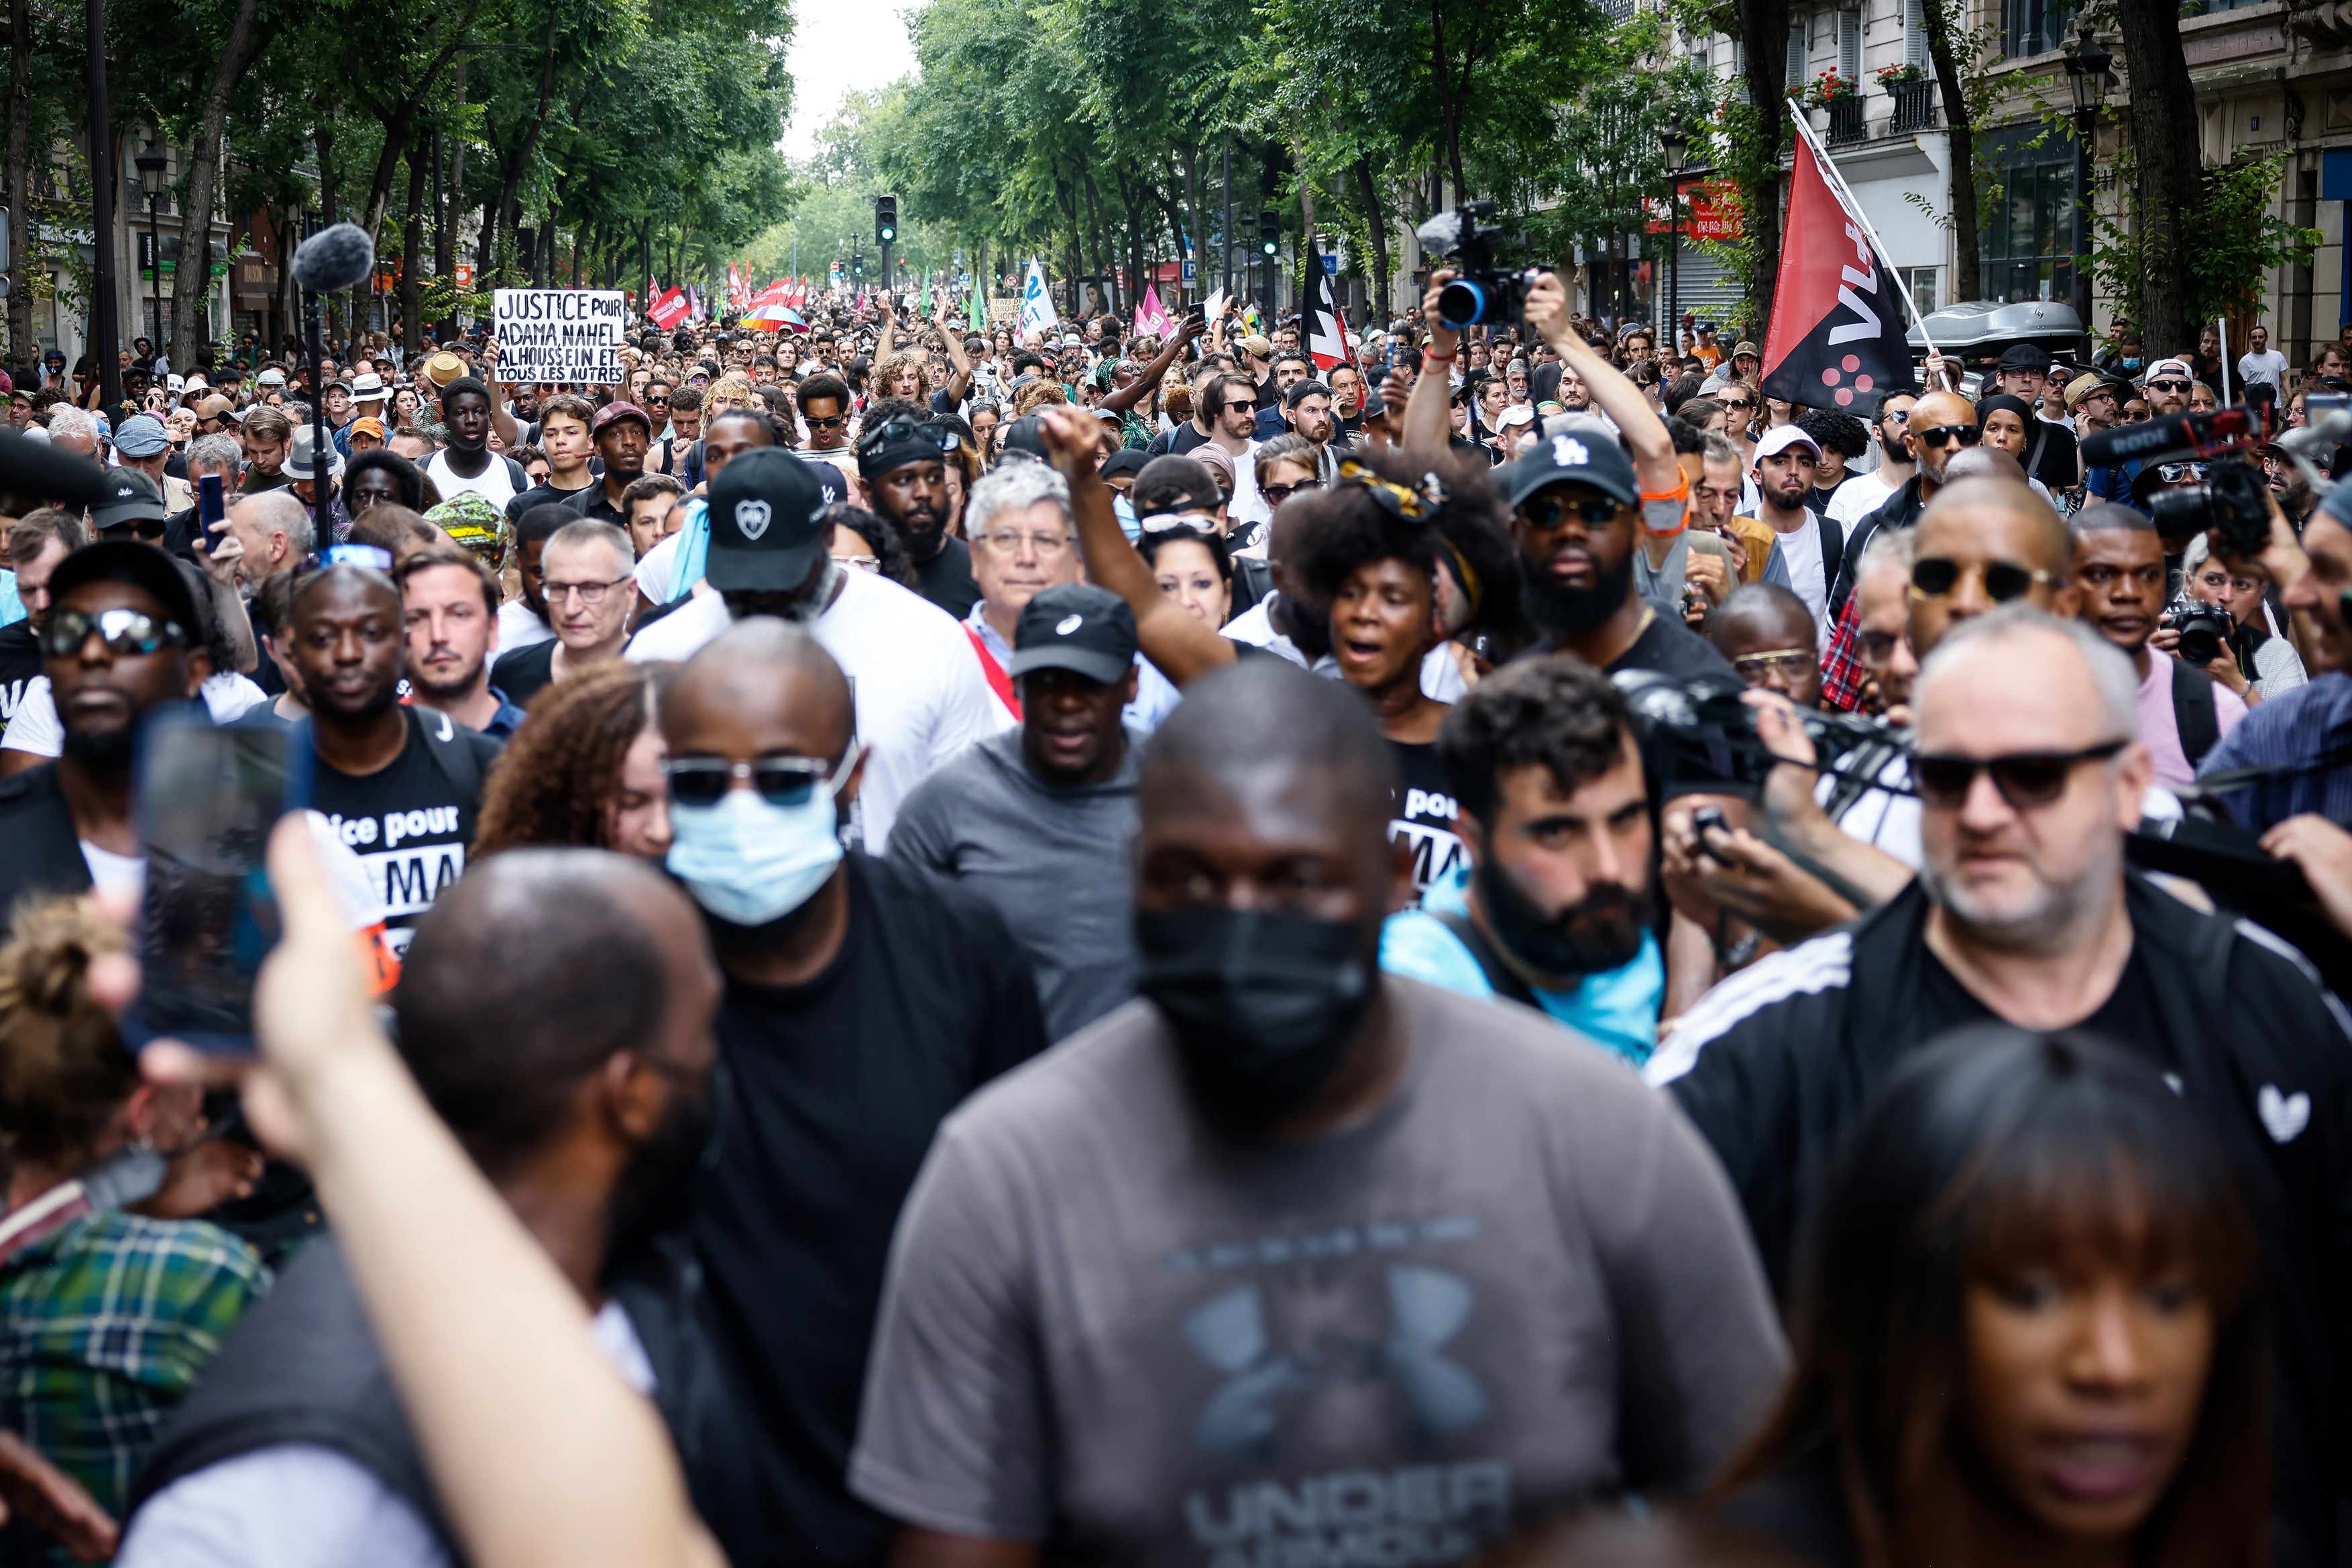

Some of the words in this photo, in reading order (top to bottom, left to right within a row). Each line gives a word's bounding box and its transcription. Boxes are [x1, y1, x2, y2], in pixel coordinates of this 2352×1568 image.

[499, 292, 589, 321] JUSTICE
[592, 297, 622, 317] POUR
[562, 324, 620, 347] NAHEL
[497, 346, 594, 368] ALHOUSSEIN
[600, 348, 616, 366] ET
[498, 367, 537, 381] TOUS
[541, 366, 565, 381] LES
[570, 367, 622, 382] AUTRES
[384, 805, 459, 848] pour
[1184, 1459, 1509, 1545] UNDER
